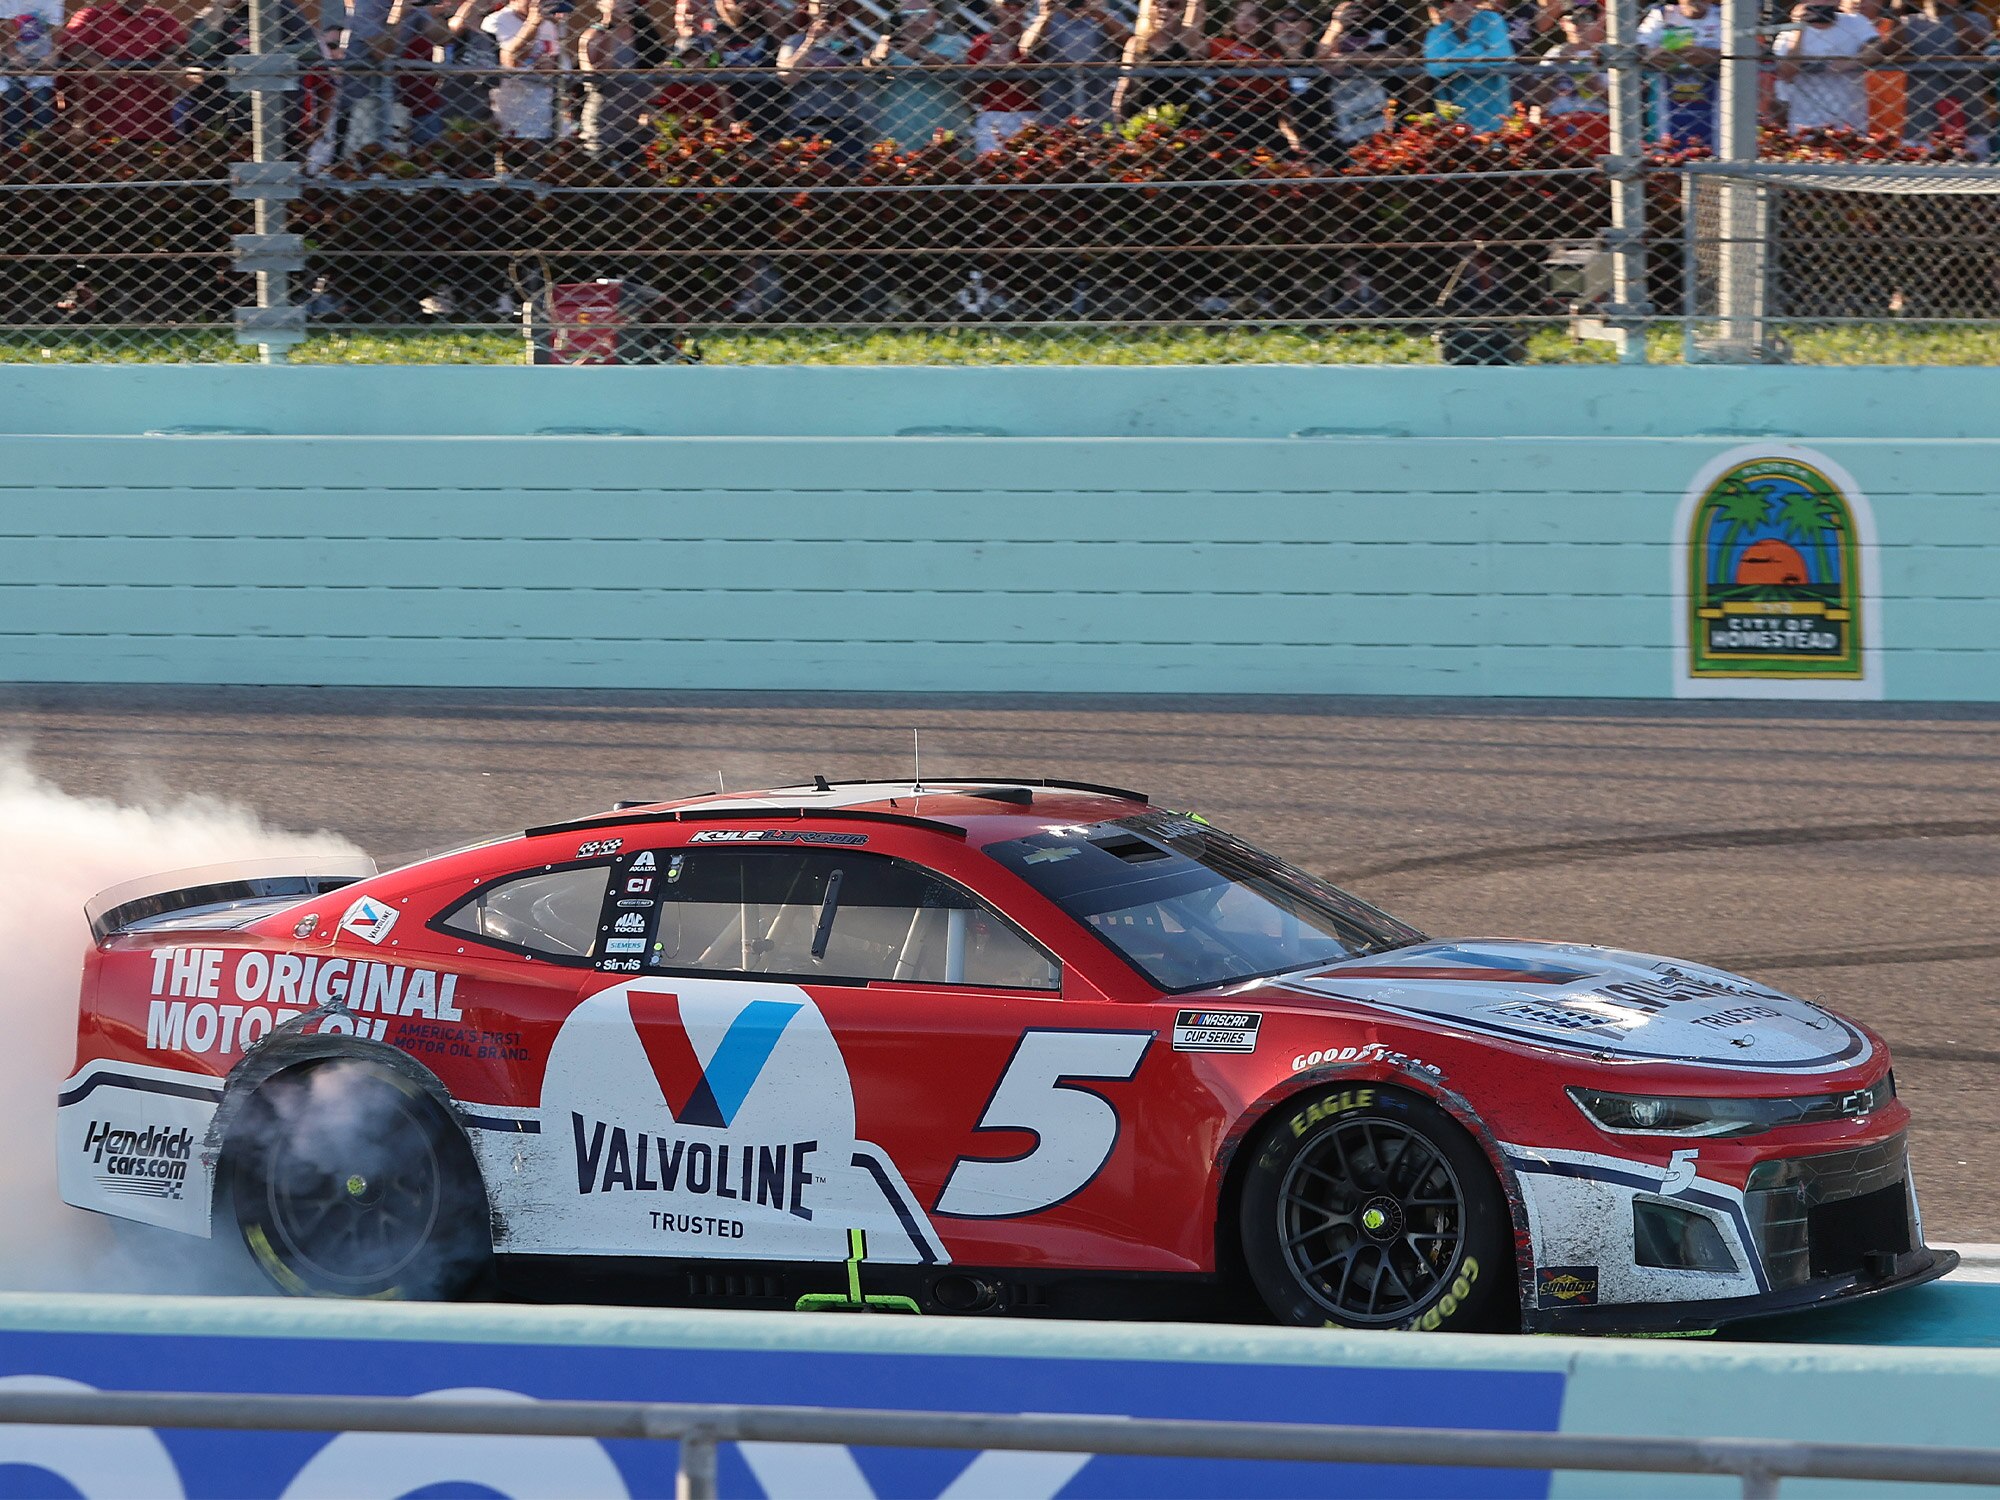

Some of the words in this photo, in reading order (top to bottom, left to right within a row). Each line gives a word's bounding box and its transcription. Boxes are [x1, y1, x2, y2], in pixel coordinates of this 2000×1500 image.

[1729, 617, 1781, 630] CITY
[1785, 618, 1814, 630] OF
[1711, 631, 1837, 649] HOMESTEAD
[368, 910, 392, 939] VALVOLINE
[615, 912, 645, 927] MAC
[150, 948, 224, 998] THE
[234, 951, 464, 1022] ORIGINAL
[1202, 1014, 1249, 1027] NASCAR
[1690, 1006, 1783, 1030] TRUSTED
[398, 1023, 478, 1042] AMERICA'S
[482, 1031, 523, 1045] FIRST
[1184, 1030, 1207, 1042] CUP
[1206, 1032, 1246, 1044] SERIES
[394, 1036, 446, 1054] MOTOR
[449, 1043, 473, 1057] OIL
[478, 1046, 531, 1061] BRAND.
[930, 1026, 1160, 1220] 5
[1289, 1088, 1376, 1139] EAGLE
[83, 1120, 194, 1164] Hendrick
[107, 1156, 188, 1180] cars.com
[571, 1110, 818, 1222] VALVOLINE
[1658, 1148, 1699, 1195] 5
[649, 1210, 744, 1239] TRUSTED
[1539, 1280, 1596, 1296] SUNOCO
